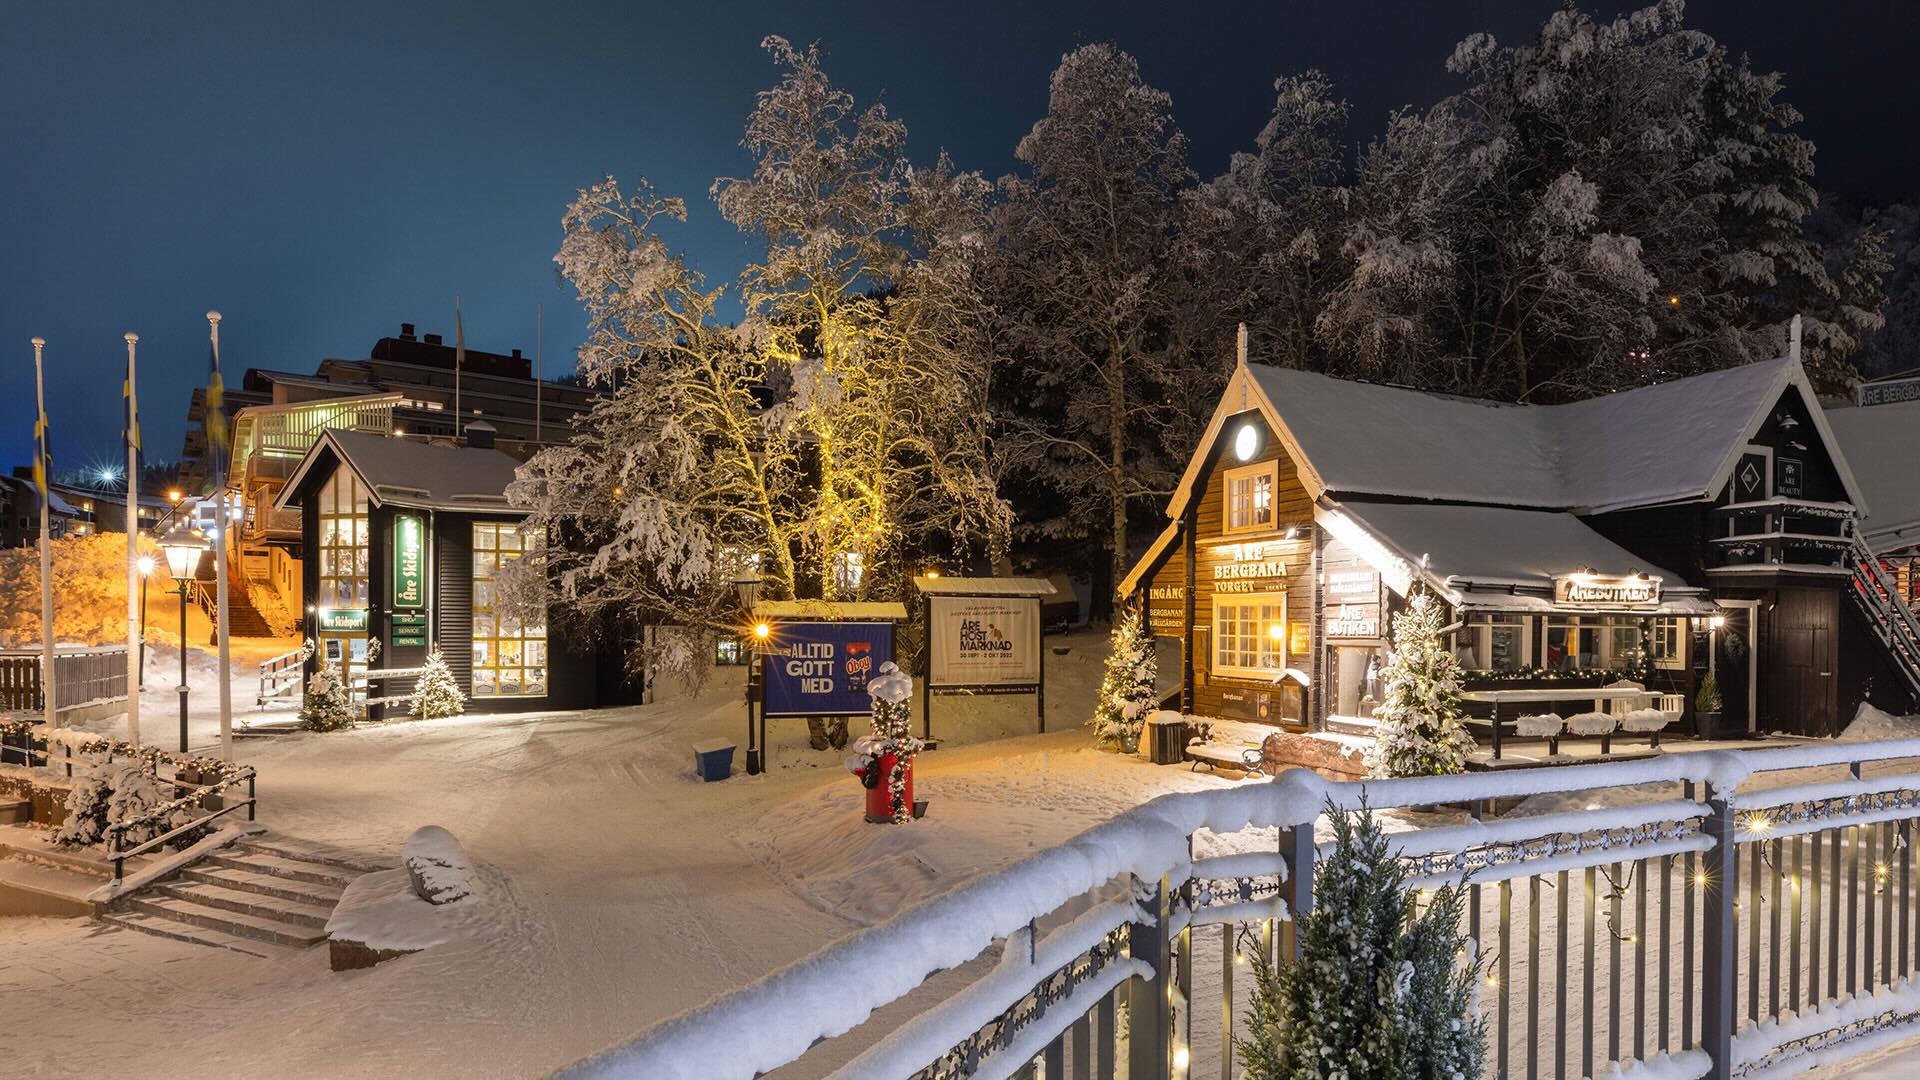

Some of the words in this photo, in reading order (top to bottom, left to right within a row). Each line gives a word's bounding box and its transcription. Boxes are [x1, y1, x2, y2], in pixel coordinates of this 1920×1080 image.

[1214, 560, 1287, 579] BERGBANA
[399, 580, 417, 600] Åre
[1150, 584, 1183, 599] INGÅNG
[1214, 581, 1255, 592] TORGET
[335, 615, 363, 629] Skidsport
[960, 619, 980, 631] ÅRE
[1328, 621, 1376, 636] BUTIKEN
[791, 643, 834, 659] ALLTID
[960, 641, 1013, 651] MARKNAD
[786, 660, 834, 676] GOTT
[801, 678, 834, 693] MED
